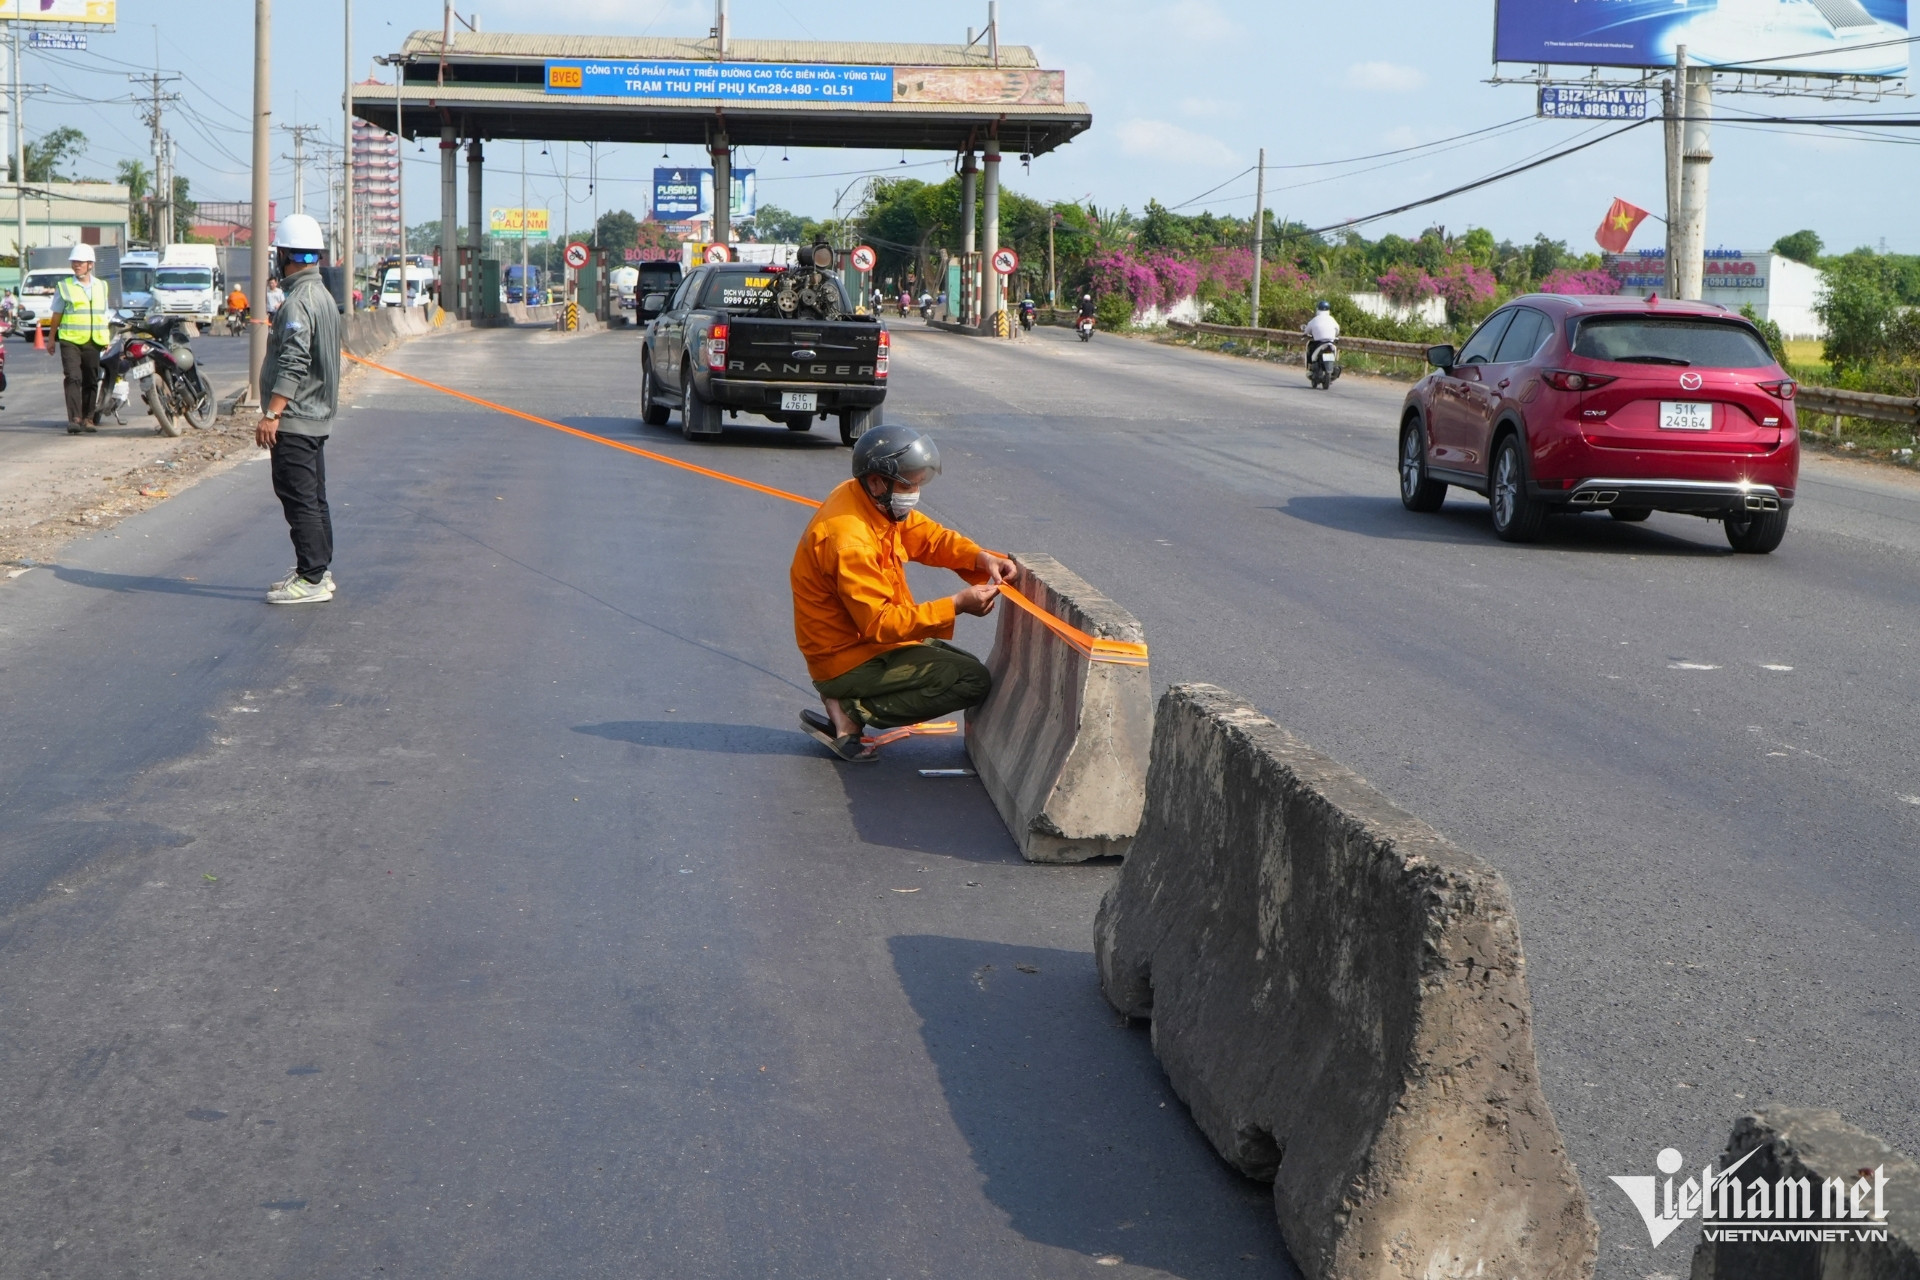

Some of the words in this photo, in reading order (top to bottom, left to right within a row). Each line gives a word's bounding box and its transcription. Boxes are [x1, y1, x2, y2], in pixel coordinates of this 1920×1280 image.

[552, 71, 579, 83] BVEC
[585, 64, 611, 75] CÔNG
[613, 66, 624, 75] TY
[626, 63, 640, 76] CỔ
[667, 66, 691, 77] PHÁT
[693, 65, 719, 78] TRIỂN
[721, 67, 752, 78] ĐƯỜNG
[754, 70, 773, 79] CAO
[775, 67, 793, 79] TỐC
[795, 69, 815, 79] BIÊN
[843, 70, 868, 80] VŨNG
[870, 70, 887, 80] TÀU
[625, 80, 662, 93] TRẠM
[665, 81, 691, 92] THU
[694, 80, 716, 93] PHÍ
[718, 82, 745, 96] PHỤ
[748, 83, 812, 95] Km28+480
[822, 84, 854, 96] QL51
[1558, 89, 1645, 104] BIZMAN.VN
[1703, 261, 1756, 275] ANG
[723, 289, 738, 297] DỊCH
[738, 290, 746, 298] VỤ
[723, 296, 742, 304] 0989
[729, 360, 874, 376] RANGER
[791, 393, 807, 402] 61C
[785, 402, 812, 410] 476.01
[1675, 403, 1697, 415] 51K
[1666, 415, 1706, 428] 249.64
